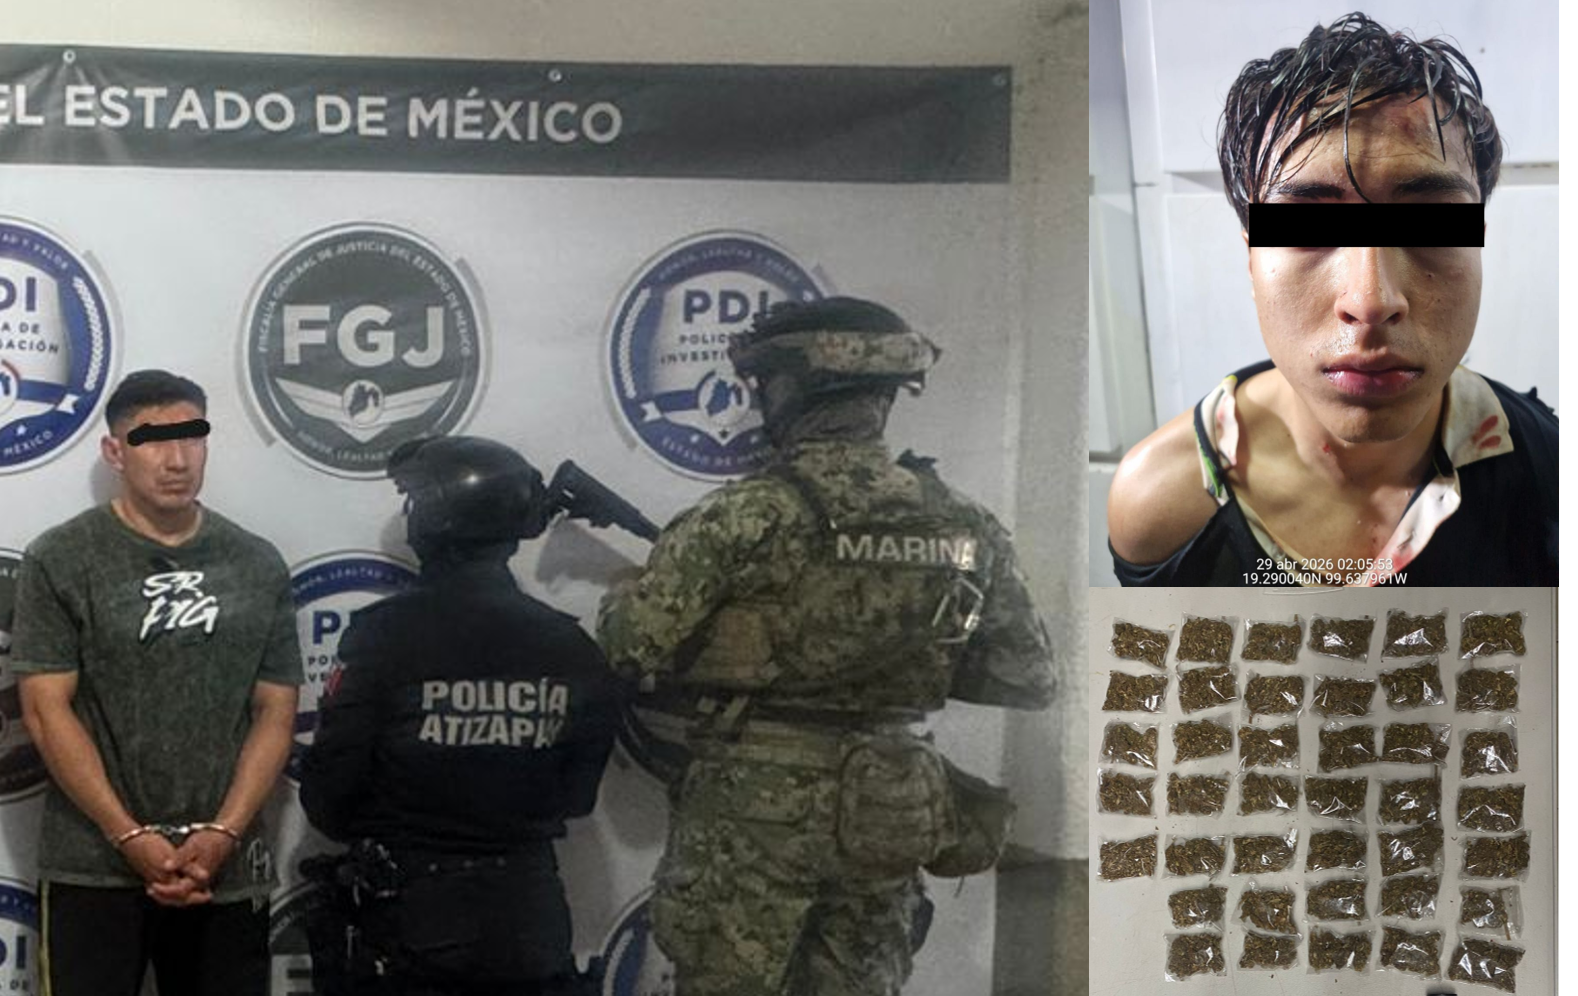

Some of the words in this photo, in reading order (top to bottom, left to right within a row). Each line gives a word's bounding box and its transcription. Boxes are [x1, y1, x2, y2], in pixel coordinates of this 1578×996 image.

[65, 84, 296, 133] ESTADO
[316, 94, 389, 137] DE
[408, 88, 623, 144] MÉXICO
[413, 254, 451, 294] ESTADO
[683, 290, 770, 324] PDI
[18, 322, 41, 335] DE
[282, 304, 444, 368] FGJ
[678, 334, 728, 345] POLIC
[836, 534, 978, 571] MARINA
[422, 677, 568, 716] POLICÍA
